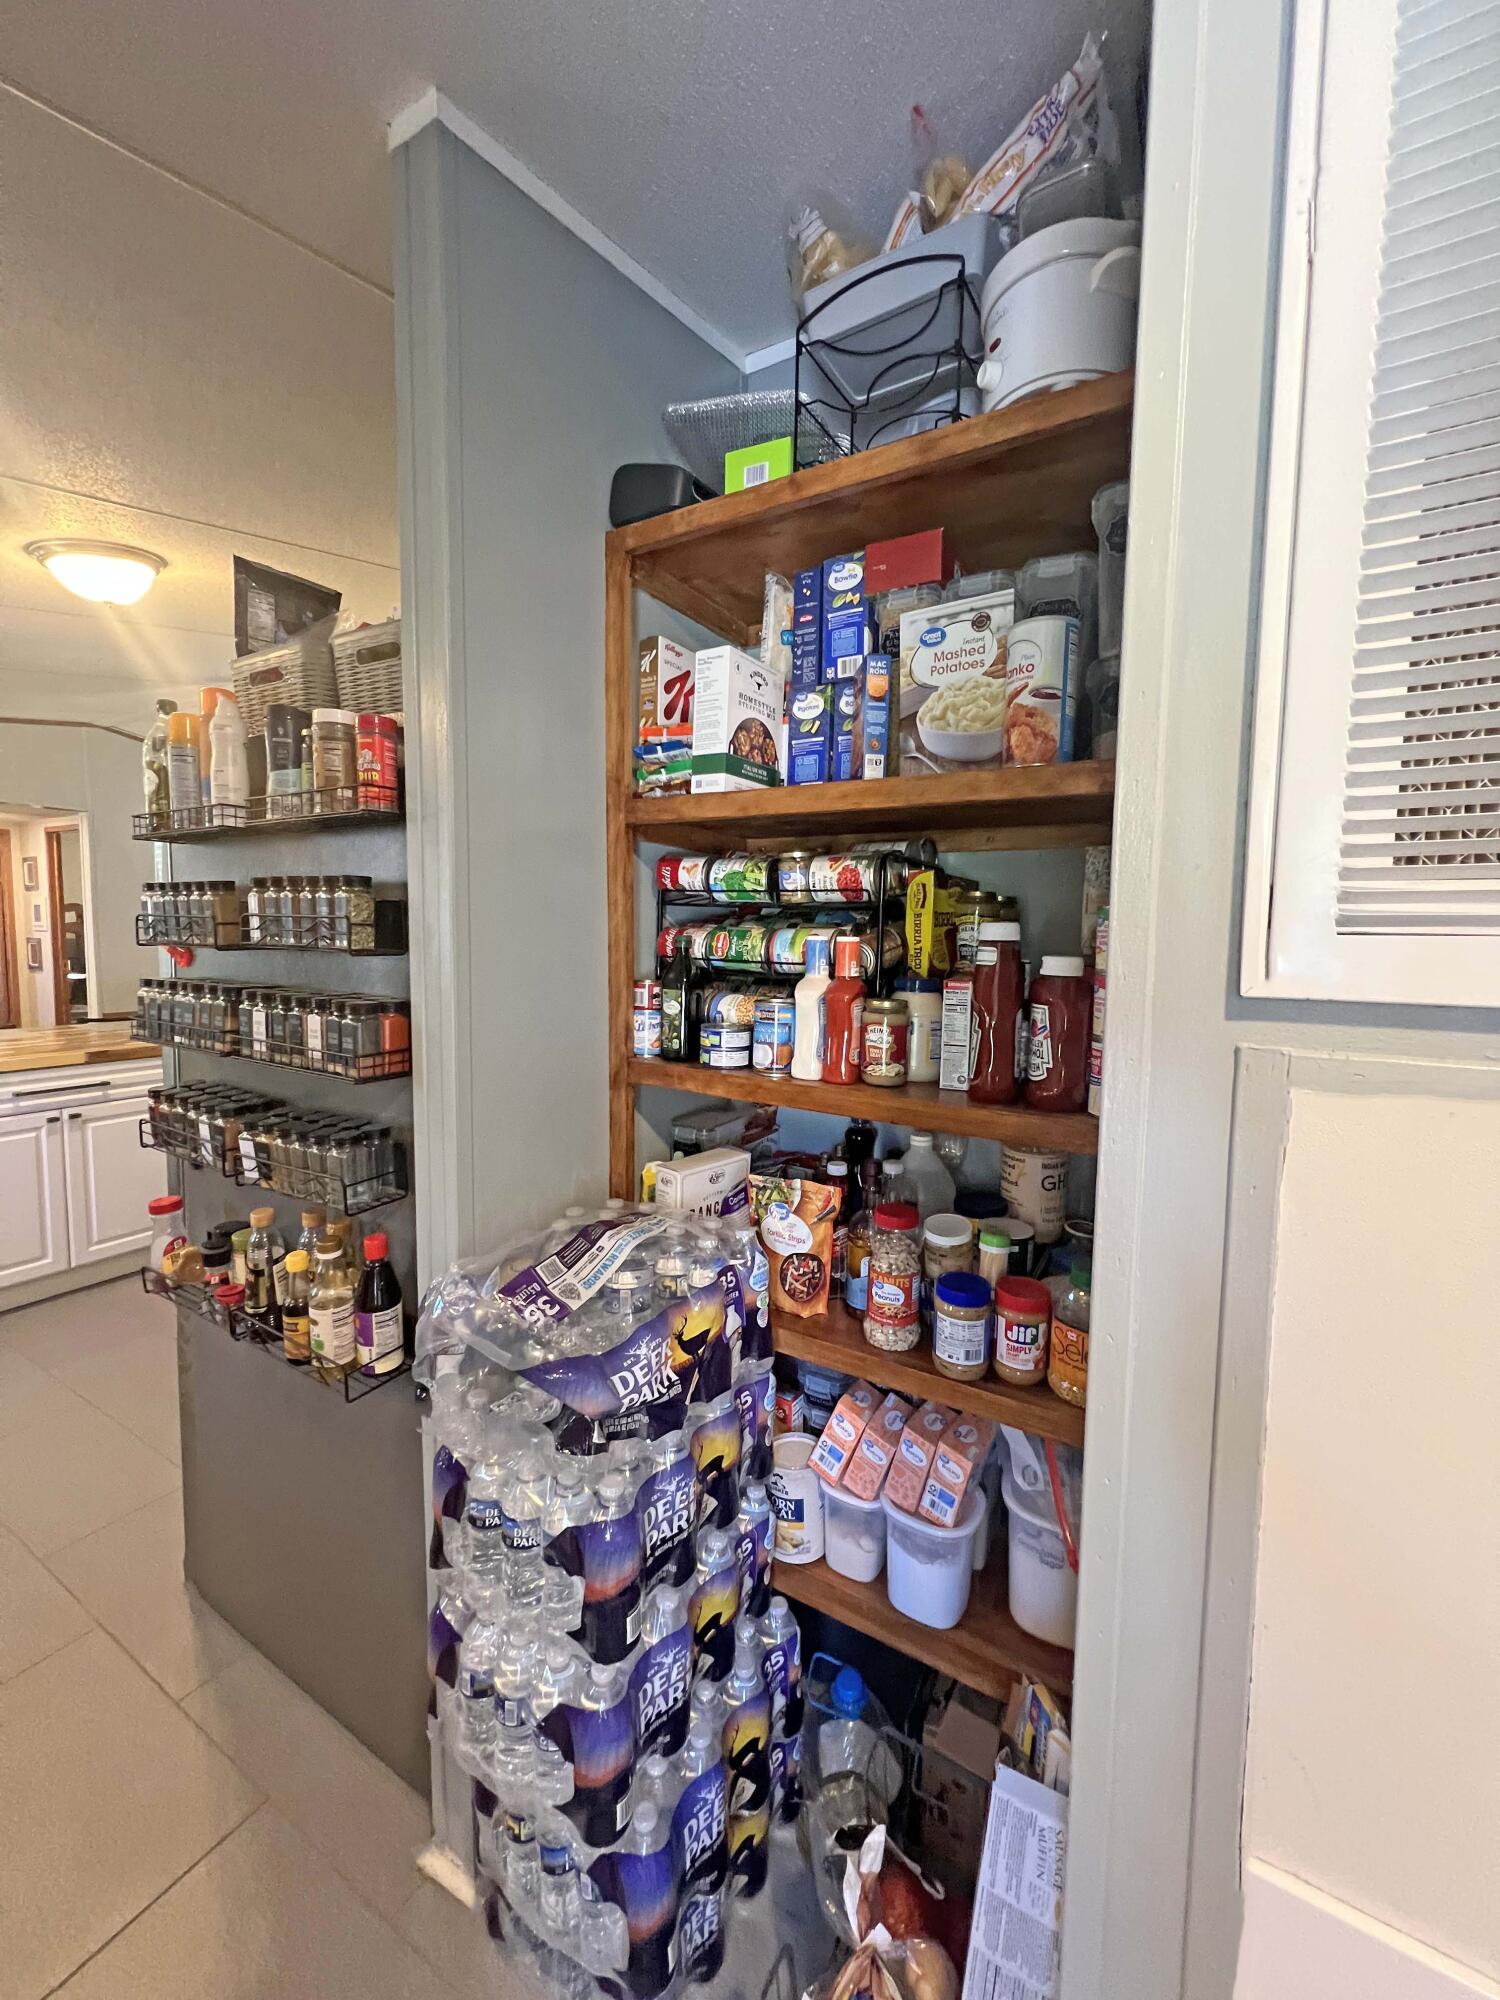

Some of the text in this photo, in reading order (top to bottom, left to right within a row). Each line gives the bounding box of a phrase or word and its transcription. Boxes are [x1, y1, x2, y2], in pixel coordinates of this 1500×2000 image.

[921, 631, 942, 640] Great
[962, 635, 985, 645] Instant
[933, 644, 986, 663] Mashed
[930, 659, 985, 676] Potatoes
[1007, 662, 1035, 680] anko
[738, 692, 777, 715] HOMESTYLE
[738, 701, 766, 718] STUFFING
[822, 875, 830, 896] Kdney
[914, 912, 923, 945] BIRRIA
[914, 946, 922, 970] TACO
[787, 1234, 806, 1244] Strips
[719, 1271, 737, 1291] 35
[874, 1291, 901, 1303] Peanuts
[1006, 1325, 1037, 1343] Jif
[1006, 1343, 1033, 1355] SIMPLY
[1054, 1326, 1088, 1365] Sel
[610, 1337, 673, 1398] DEER
[619, 1356, 680, 1413] PARK
[771, 1498, 795, 1511] ORN
[779, 1510, 796, 1520] AL
[764, 1650, 785, 1683] 35
[1036, 1825, 1047, 1881] MUFFIN
[1052, 1829, 1064, 1894] SAUSAGE
